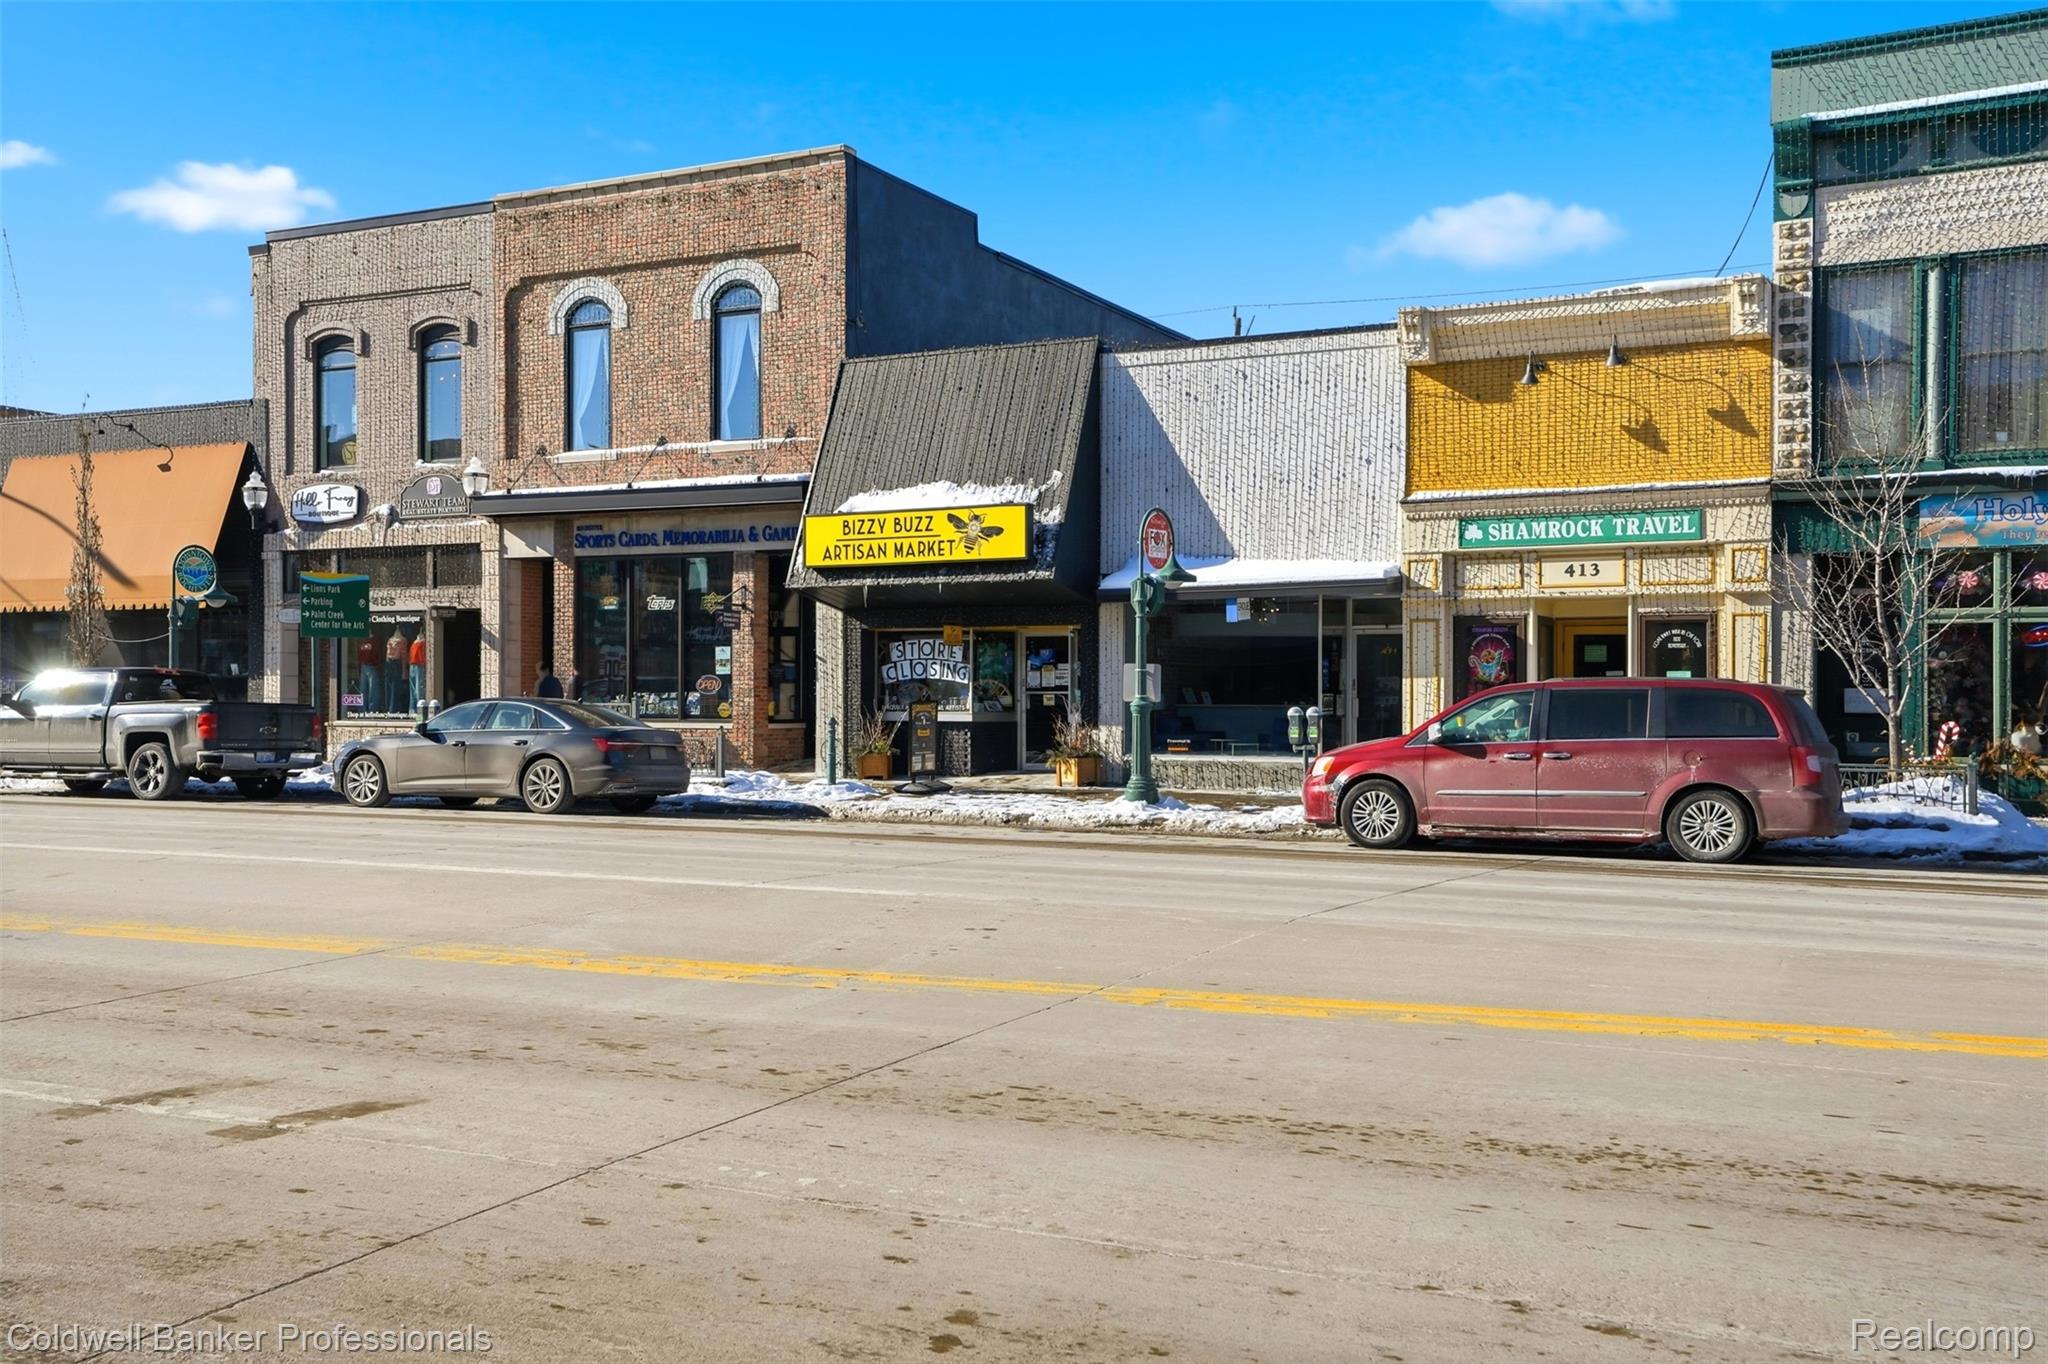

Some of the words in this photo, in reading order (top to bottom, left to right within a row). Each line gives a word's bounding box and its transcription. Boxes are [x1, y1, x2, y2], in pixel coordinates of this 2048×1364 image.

[402, 497, 440, 510] STEWART
[442, 496, 466, 507] TEAM
[308, 510, 340, 518] BOUTIQUE
[417, 507, 436, 515] ESTATE
[1976, 496, 2048, 525] Holy
[842, 516, 887, 536] BIZZY
[893, 515, 934, 534] BUZZ
[1488, 519, 1604, 542] SHAMROCK
[1612, 515, 1696, 536] TRAVEL
[574, 533, 616, 549] SPORTS
[662, 528, 744, 546] MEMORABILIA
[748, 525, 759, 542] &
[2001, 529, 2032, 542] They
[822, 543, 887, 562] ARTISAN
[893, 540, 956, 558] MARKET
[1564, 563, 1600, 578] 413
[310, 584, 326, 593] Lions
[327, 584, 341, 594] Park
[310, 597, 334, 608] Parking
[310, 610, 326, 618] Paint
[327, 610, 345, 619] Creek
[371, 615, 395, 624] Clothing
[396, 614, 421, 624] Boutique
[310, 620, 330, 629] Center
[331, 620, 341, 629] for
[342, 620, 352, 629] the
[353, 621, 365, 629] Arts
[895, 641, 959, 660] STORE
[886, 661, 968, 680] CLOSING
[698, 679, 720, 690] OPEN
[343, 695, 362, 704] OPEN
